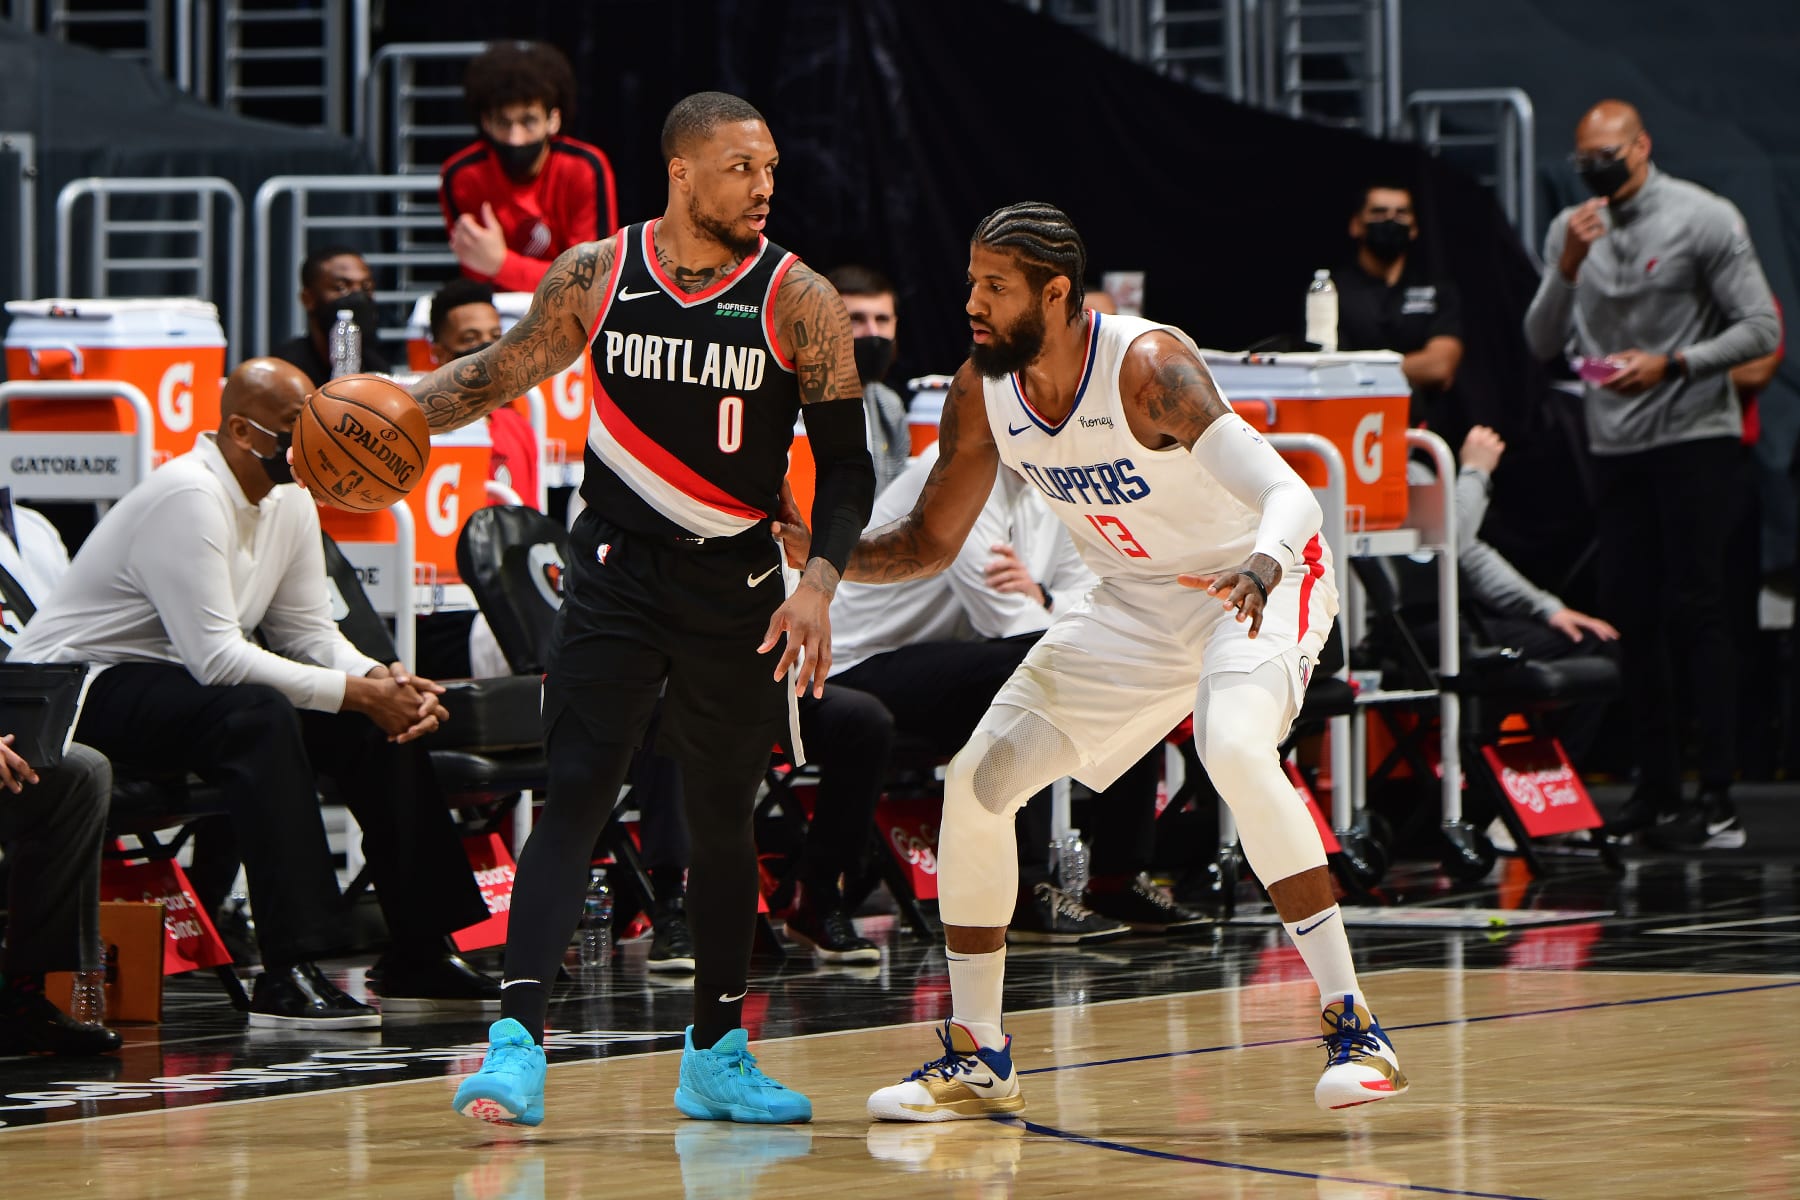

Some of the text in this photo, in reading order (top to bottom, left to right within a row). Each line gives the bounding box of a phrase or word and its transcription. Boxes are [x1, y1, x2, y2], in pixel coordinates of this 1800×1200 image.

[552, 352, 585, 421] G
[604, 330, 766, 391] PORTLAND
[158, 362, 194, 433] G
[718, 395, 744, 454] 0
[1078, 416, 1114, 429] honey
[11, 456, 120, 475] GATORADE
[333, 413, 416, 485] SPALDING
[1353, 412, 1384, 484] G
[426, 462, 461, 537] G
[1020, 458, 1151, 505] CLIPPERS
[1083, 514, 1152, 560] 13
[473, 864, 516, 888] edars
